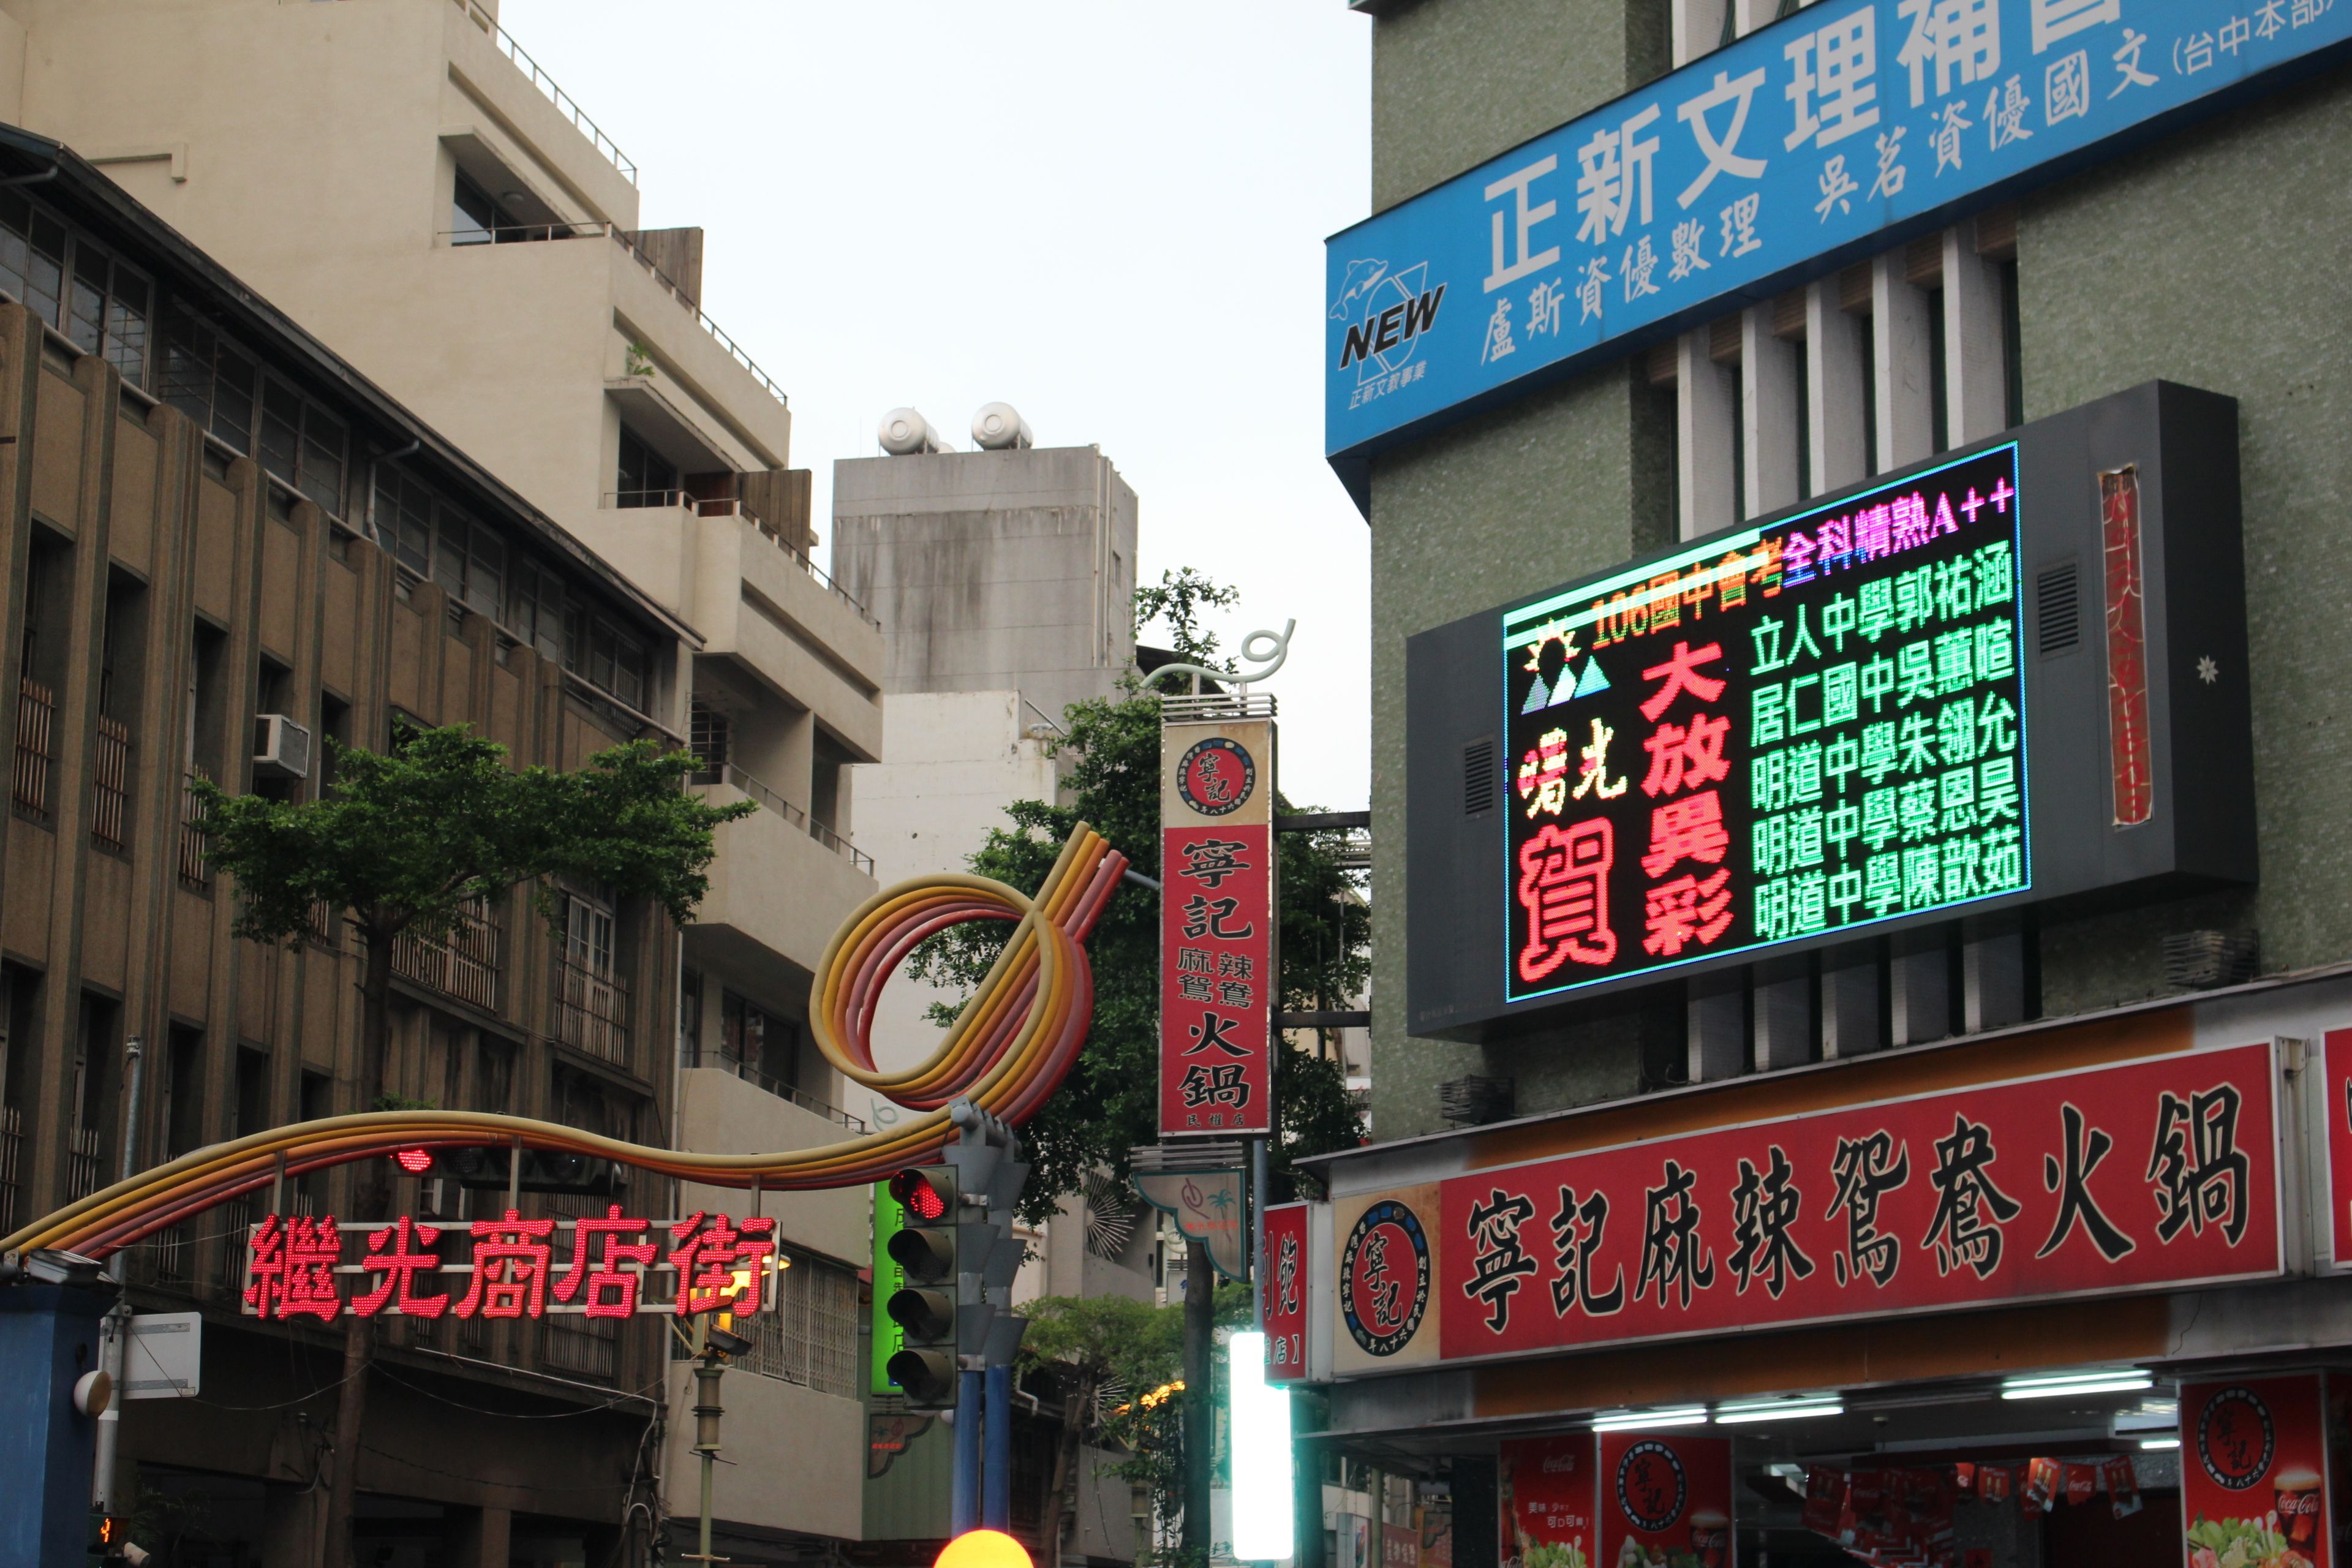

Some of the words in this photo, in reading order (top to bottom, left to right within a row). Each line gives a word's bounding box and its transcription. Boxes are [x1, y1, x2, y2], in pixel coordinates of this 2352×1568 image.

[1338, 282, 1447, 371] NEW
[1481, 192, 1762, 366] 盧斯資優數理
[1349, 360, 1427, 410] 正新文教事業
[1751, 540, 2013, 675] 立人中學郭祐涵
[1197, 752, 1231, 802] 寧記
[1640, 641, 1734, 957] 大放異彩
[1178, 839, 1254, 940] 寧記
[1517, 816, 1618, 982] 賀
[1177, 946, 1253, 981] 麻辣
[1177, 973, 1253, 1009] 鴛鴦
[1177, 1011, 1254, 1109] 火鍋
[1186, 1113, 1245, 1128] 民權店
[1463, 1081, 2250, 1336] 寧記麻辣鴛鴦火鍋
[244, 1205, 776, 1322] 繼光商店街
[1363, 1231, 1403, 1328] 寧記
